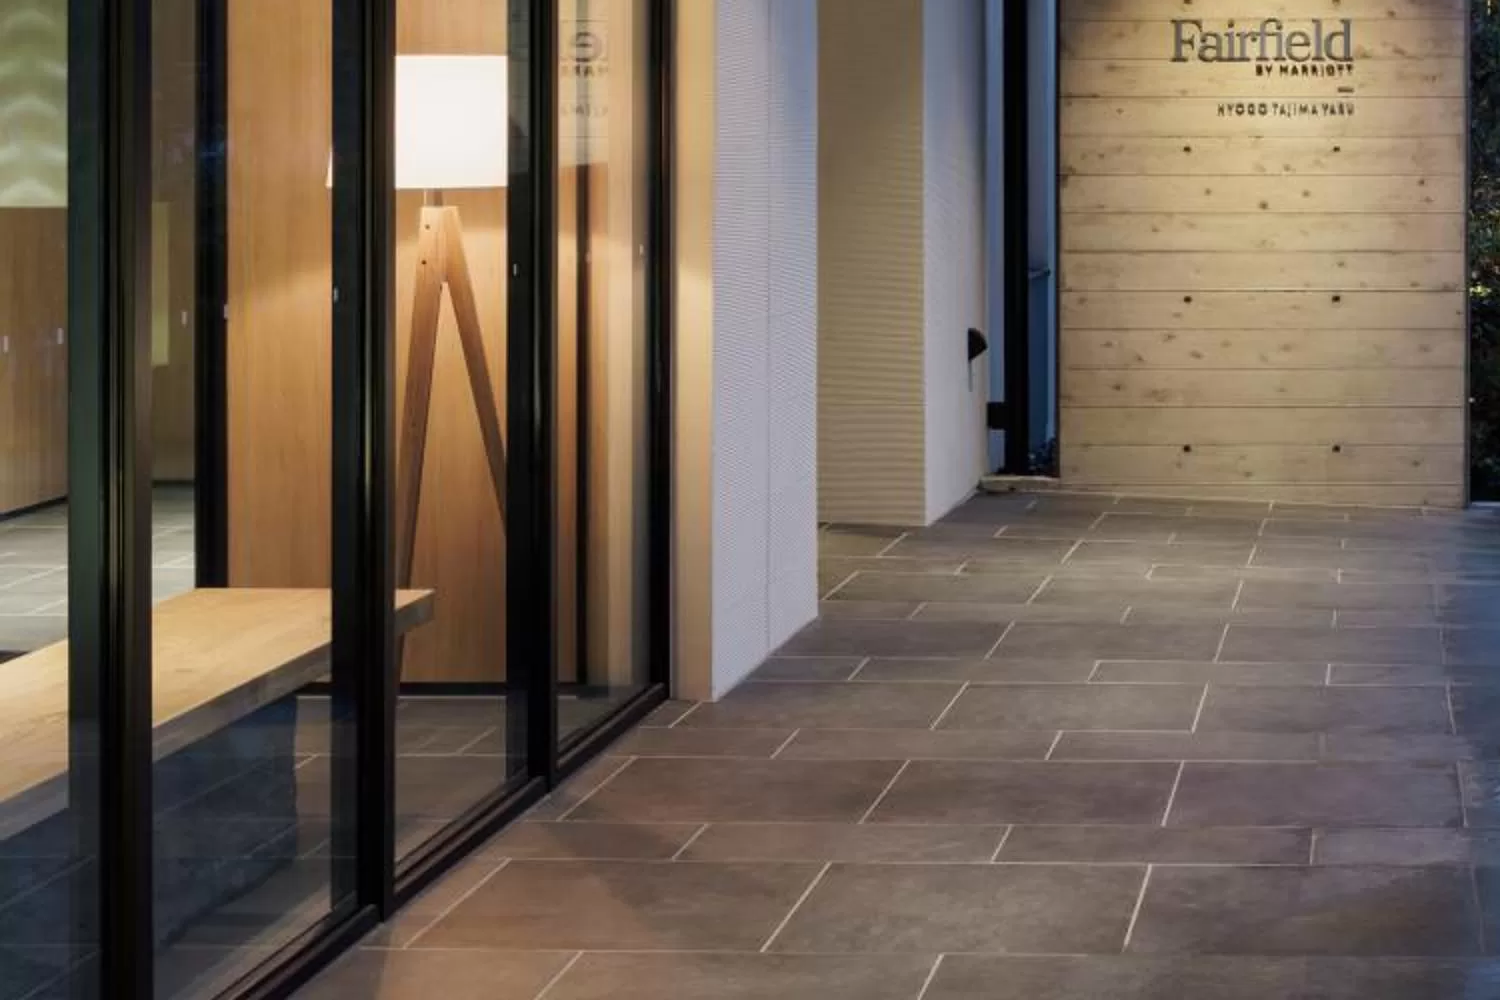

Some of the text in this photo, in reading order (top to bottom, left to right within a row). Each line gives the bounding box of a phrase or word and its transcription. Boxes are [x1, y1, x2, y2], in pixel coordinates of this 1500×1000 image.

[1170, 17, 1354, 63] Fairfield
[1255, 63, 1354, 77] BY MARRIOTT
[1217, 102, 1268, 116] HYOGO
